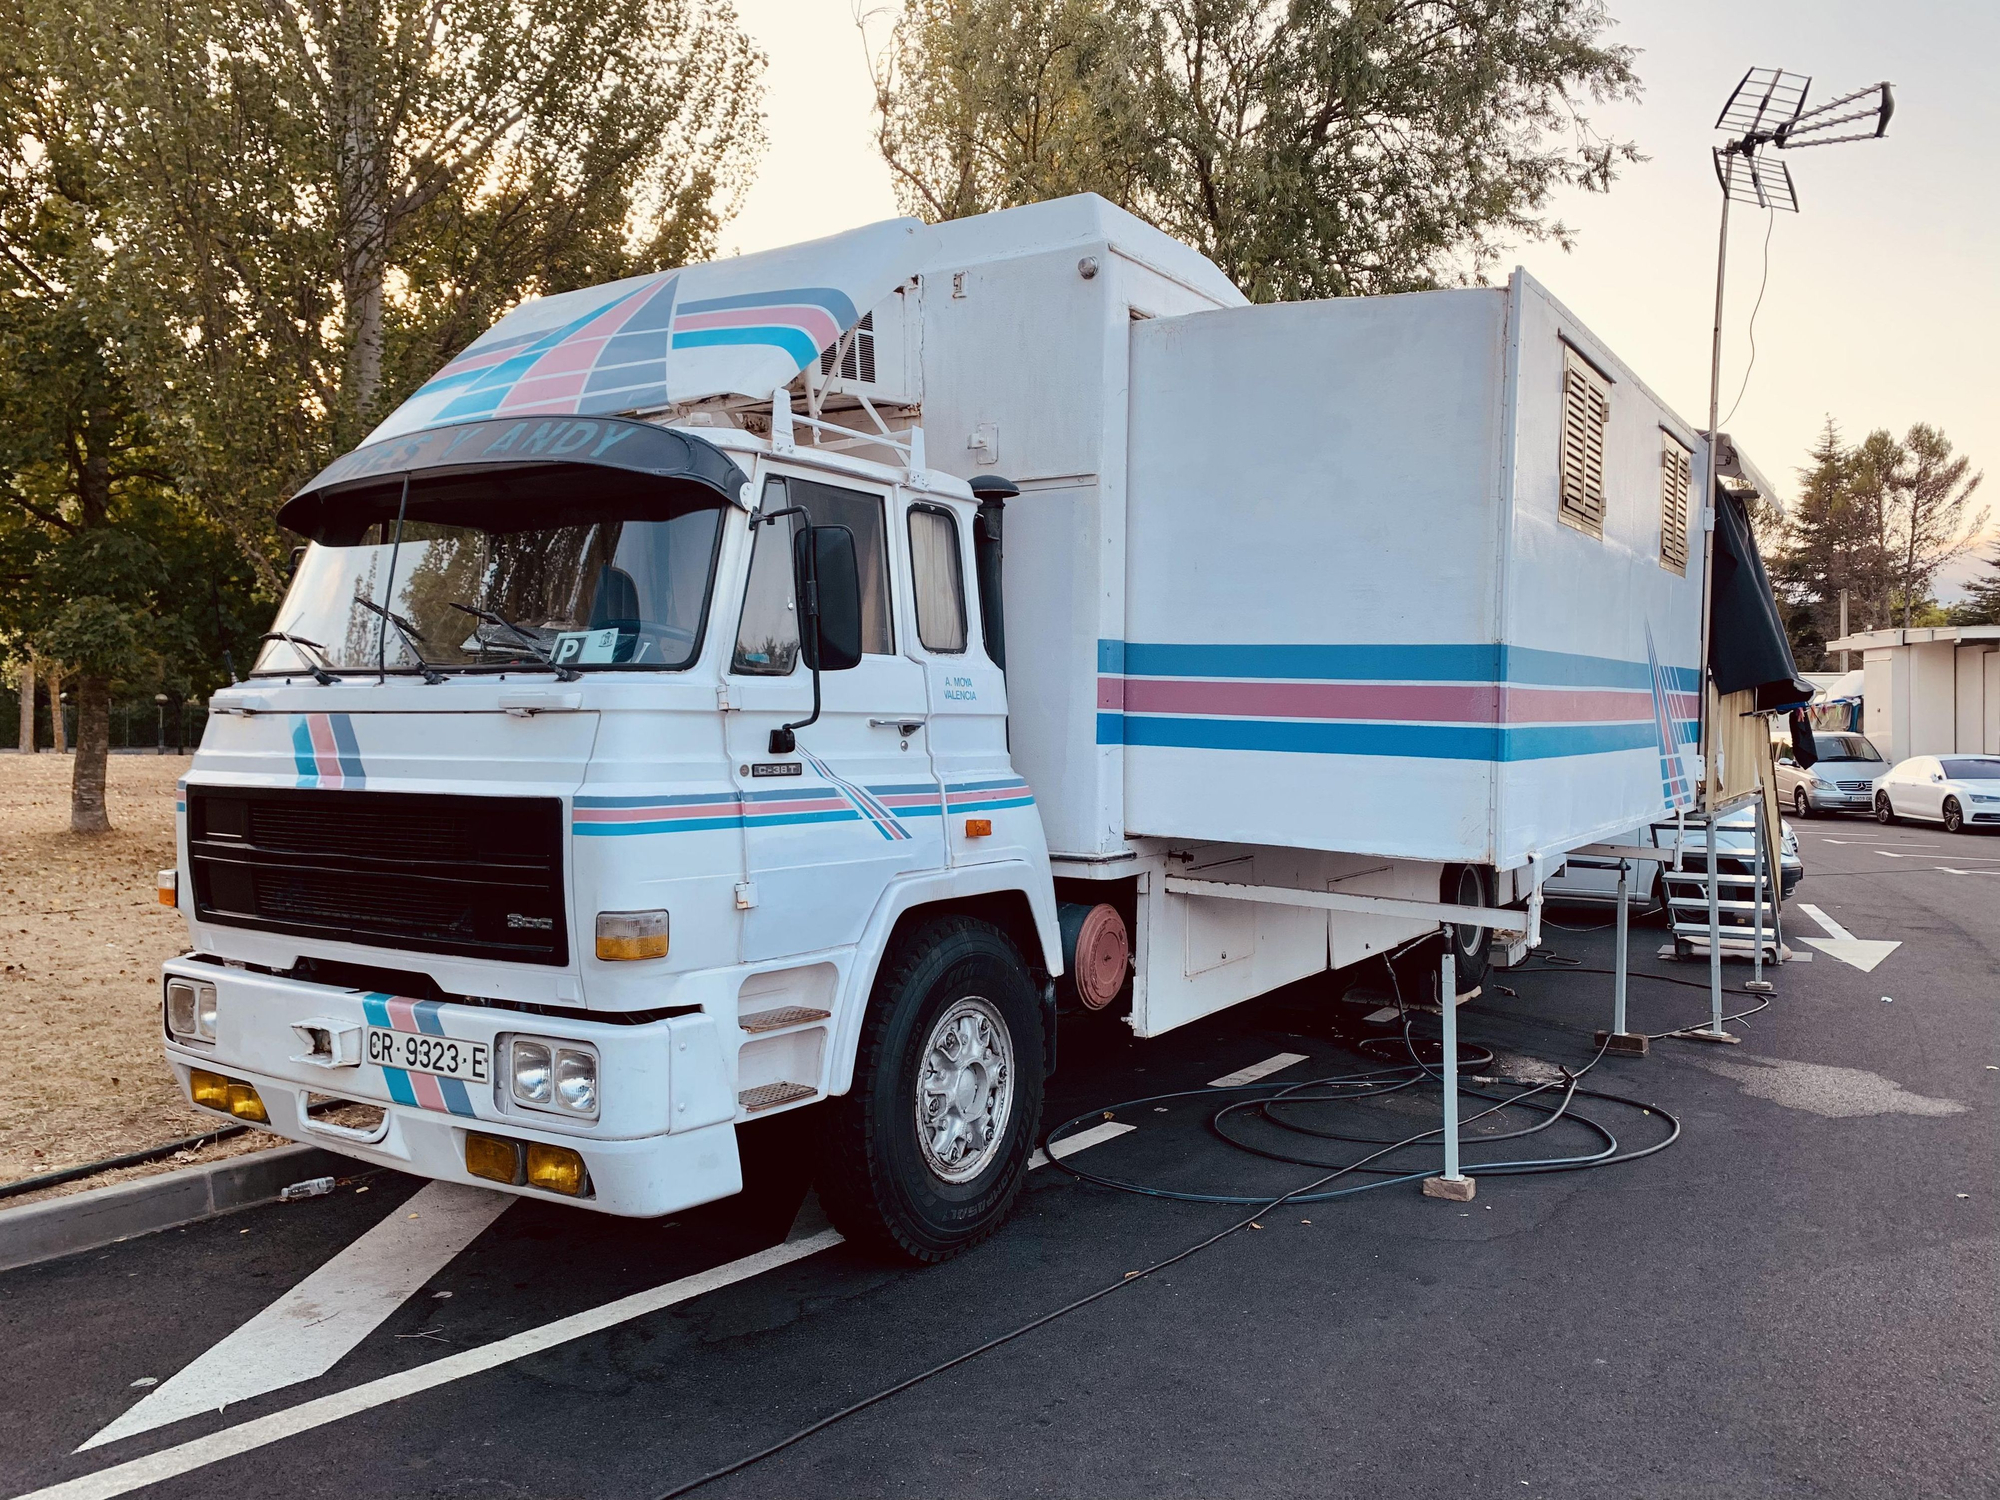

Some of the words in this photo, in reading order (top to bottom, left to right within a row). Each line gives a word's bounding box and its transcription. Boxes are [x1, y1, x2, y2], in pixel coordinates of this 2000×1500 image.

[440, 426, 485, 461] Y
[481, 422, 639, 458] ANDY
[556, 639, 579, 664] P
[945, 676, 952, 687] A.
[953, 677, 973, 687] MOYA
[943, 690, 977, 700] VALENCIA
